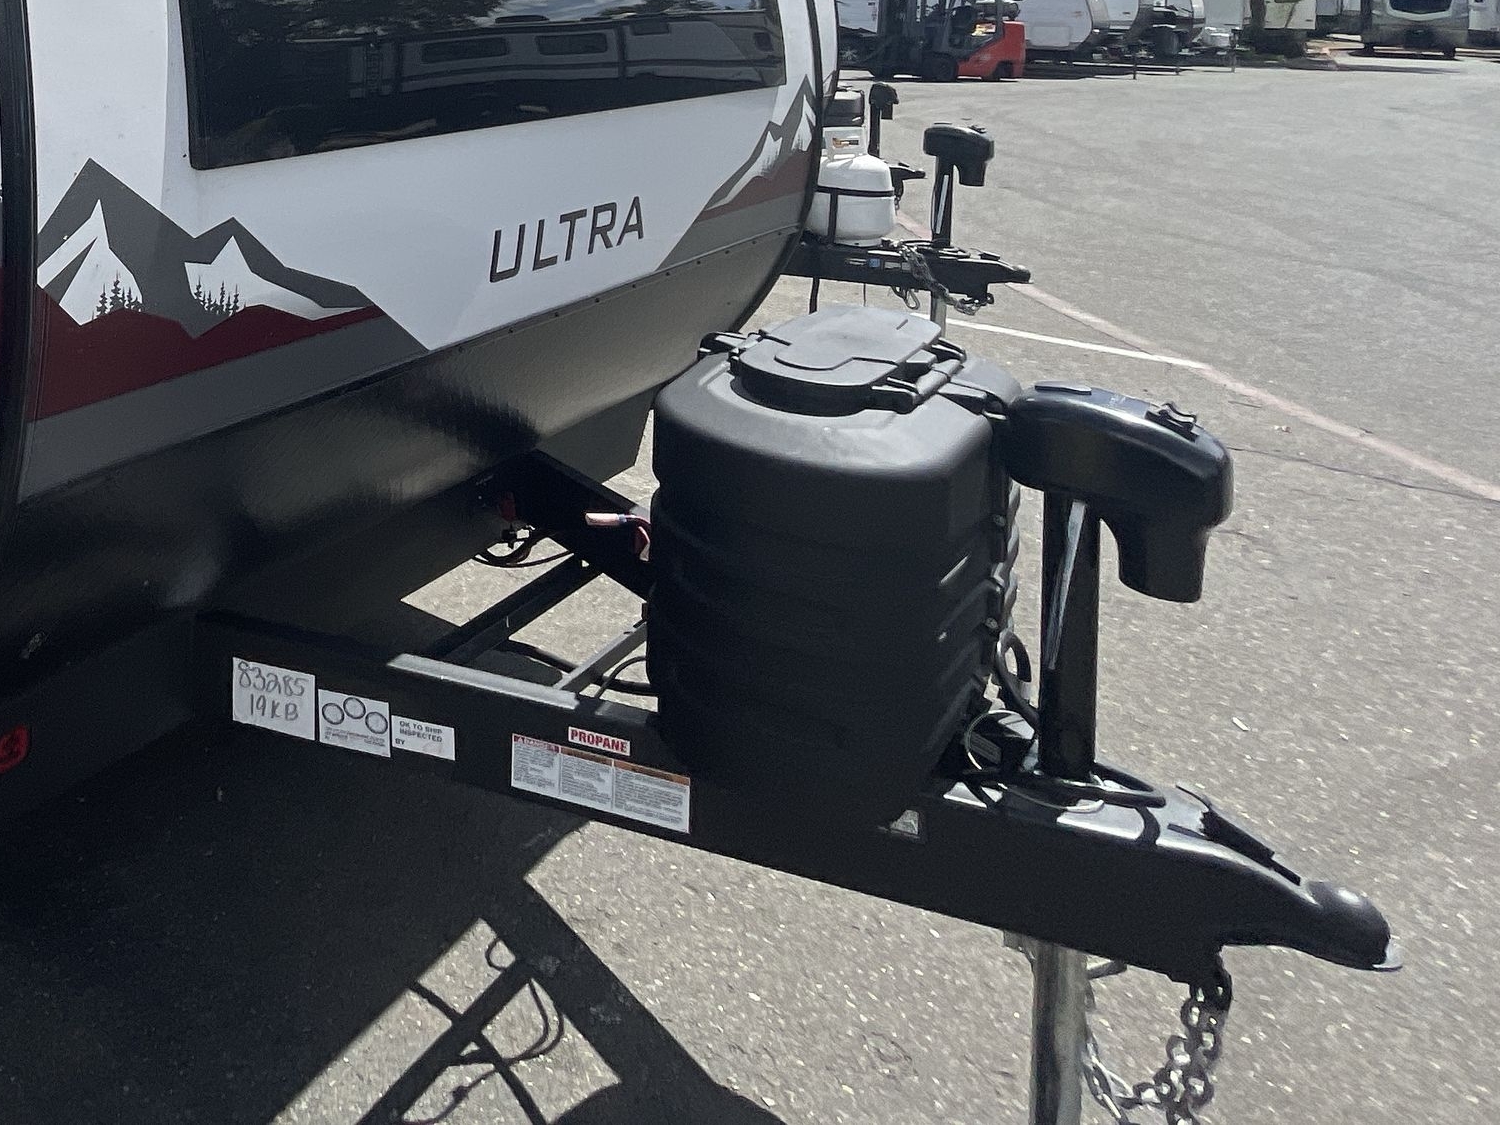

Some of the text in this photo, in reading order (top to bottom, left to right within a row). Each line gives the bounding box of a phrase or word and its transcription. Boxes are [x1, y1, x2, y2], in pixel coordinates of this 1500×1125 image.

[489, 195, 644, 283] ULTRA
[237, 660, 309, 697] 83285
[399, 728, 443, 743] INSPECTED
[413, 722, 424, 731] TO
[570, 727, 628, 753] PROPANE
